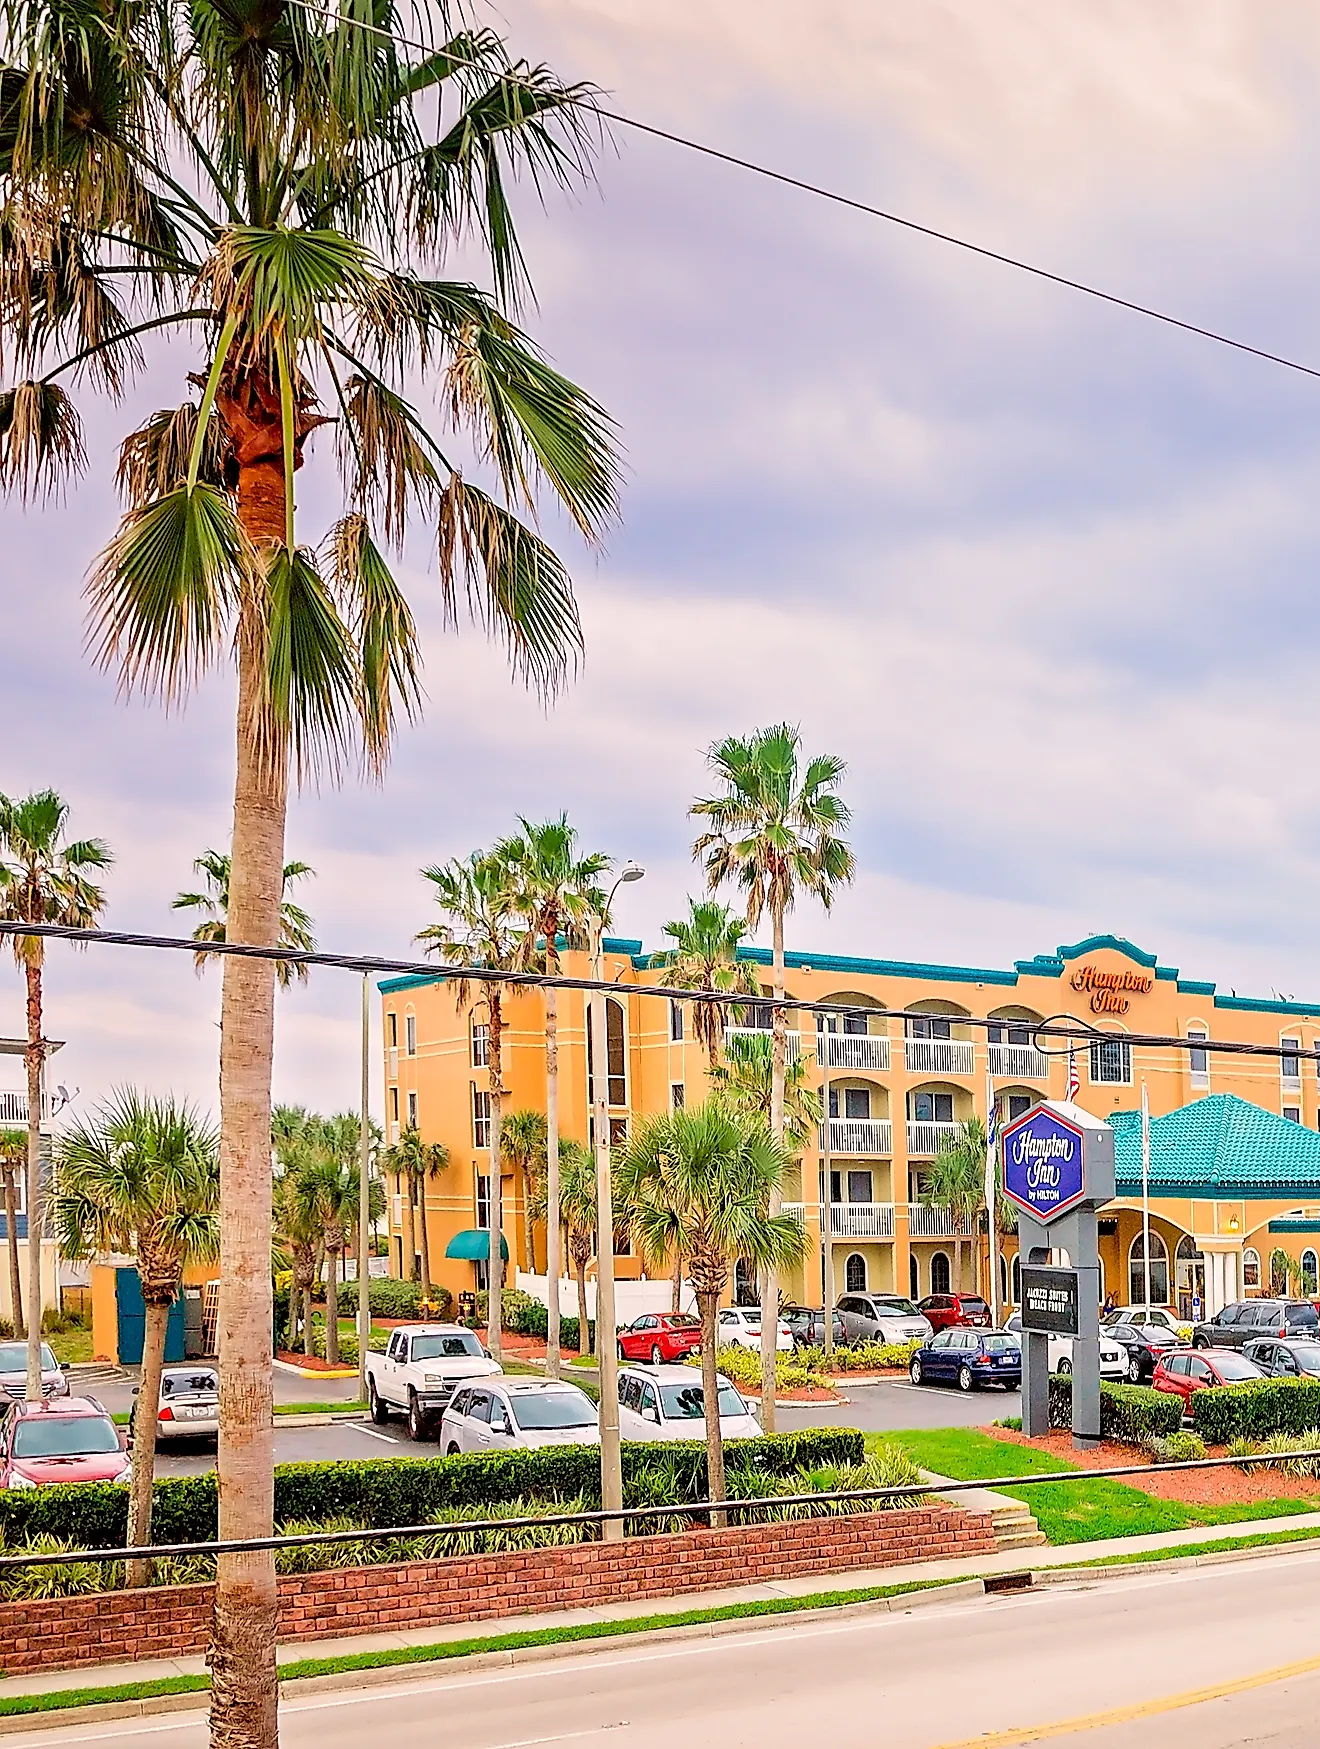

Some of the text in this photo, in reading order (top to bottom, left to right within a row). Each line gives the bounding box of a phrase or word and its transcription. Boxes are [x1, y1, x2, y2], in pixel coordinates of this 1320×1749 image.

[1070, 965, 1153, 993] Hampton
[1090, 988, 1130, 1014] Inn
[1012, 1129, 1074, 1164] Hampton
[1027, 1157, 1060, 1187] Inn
[1028, 1189, 1060, 1201] by HILTON
